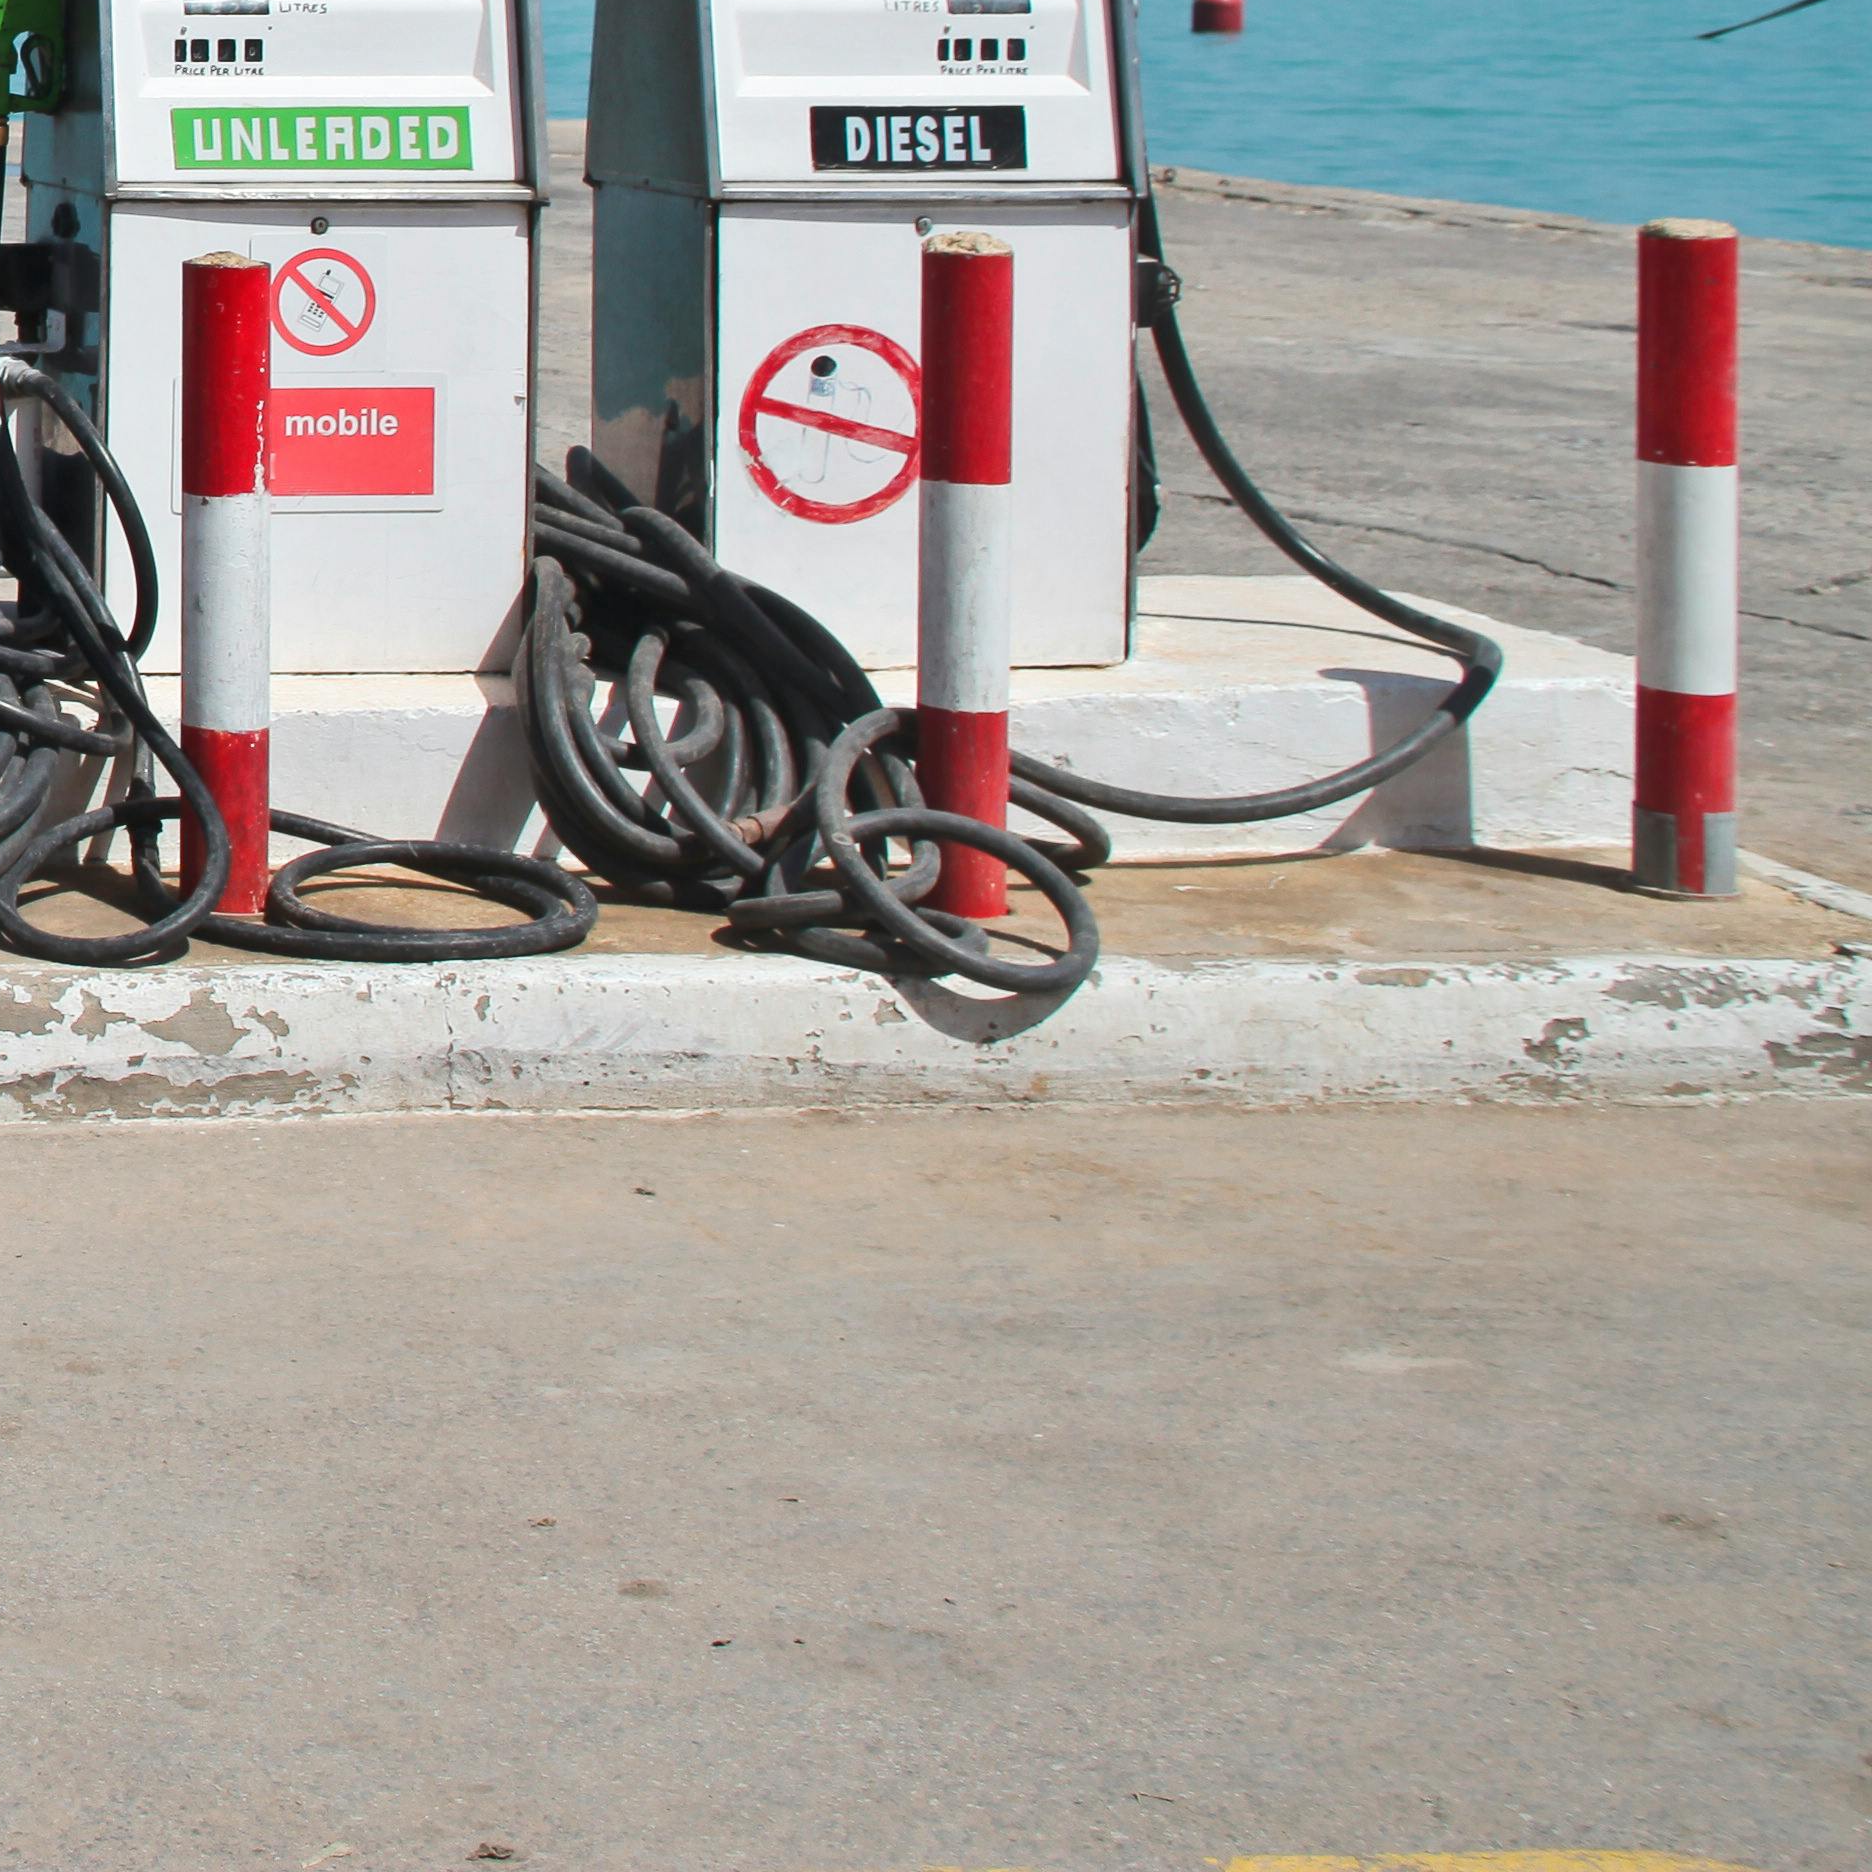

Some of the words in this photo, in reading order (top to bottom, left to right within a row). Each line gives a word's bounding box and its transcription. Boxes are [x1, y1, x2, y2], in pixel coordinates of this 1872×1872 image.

[279, 2, 328, 15] LITRES
[192, 115, 459, 162] UNLEADED
[845, 114, 992, 163] DIESEL
[284, 408, 399, 437] mobile
